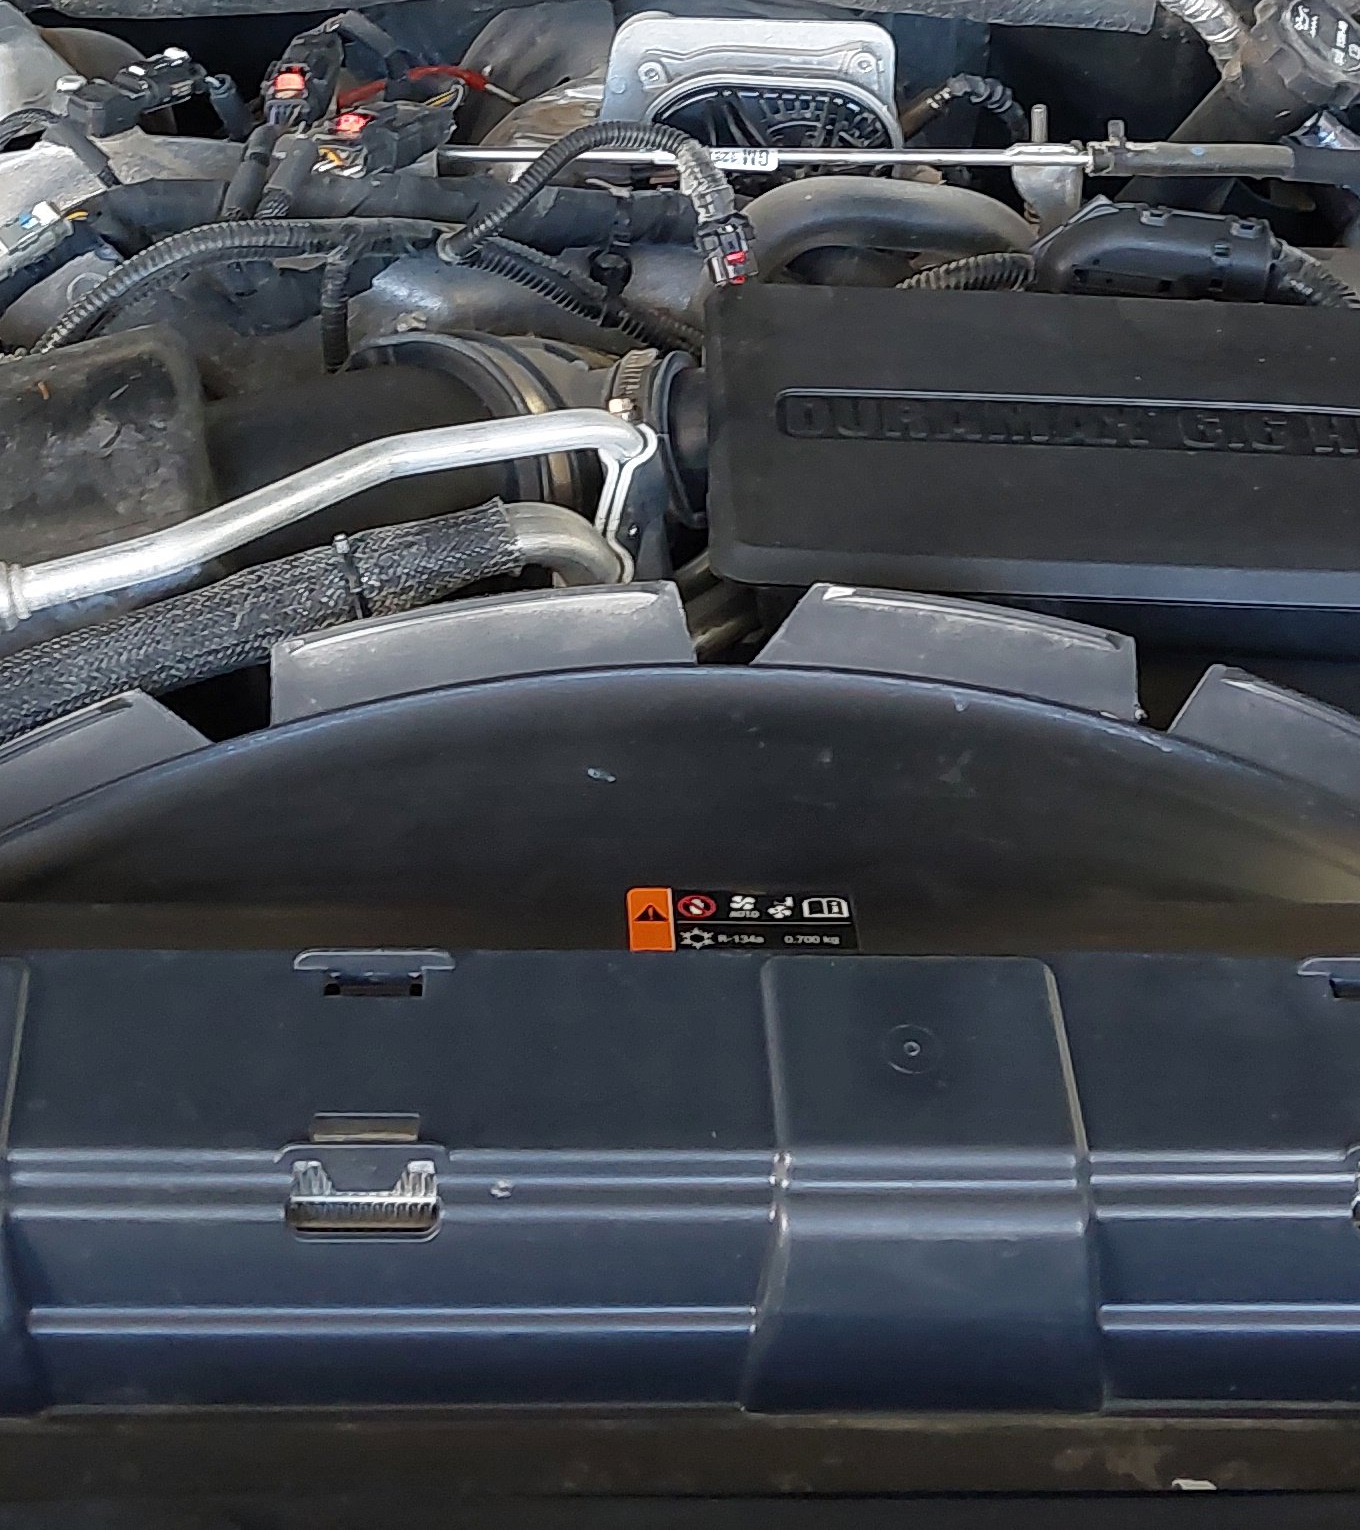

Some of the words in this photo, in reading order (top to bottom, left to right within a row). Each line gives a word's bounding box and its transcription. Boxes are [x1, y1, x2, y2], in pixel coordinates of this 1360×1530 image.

[743, 149, 769, 166] GM
[788, 397, 1153, 447] DURAMAX
[1177, 412, 1287, 450] 6.6
[718, 935, 765, 944] R-134a
[784, 935, 821, 944] 0.700
[823, 936, 840, 945] kg
